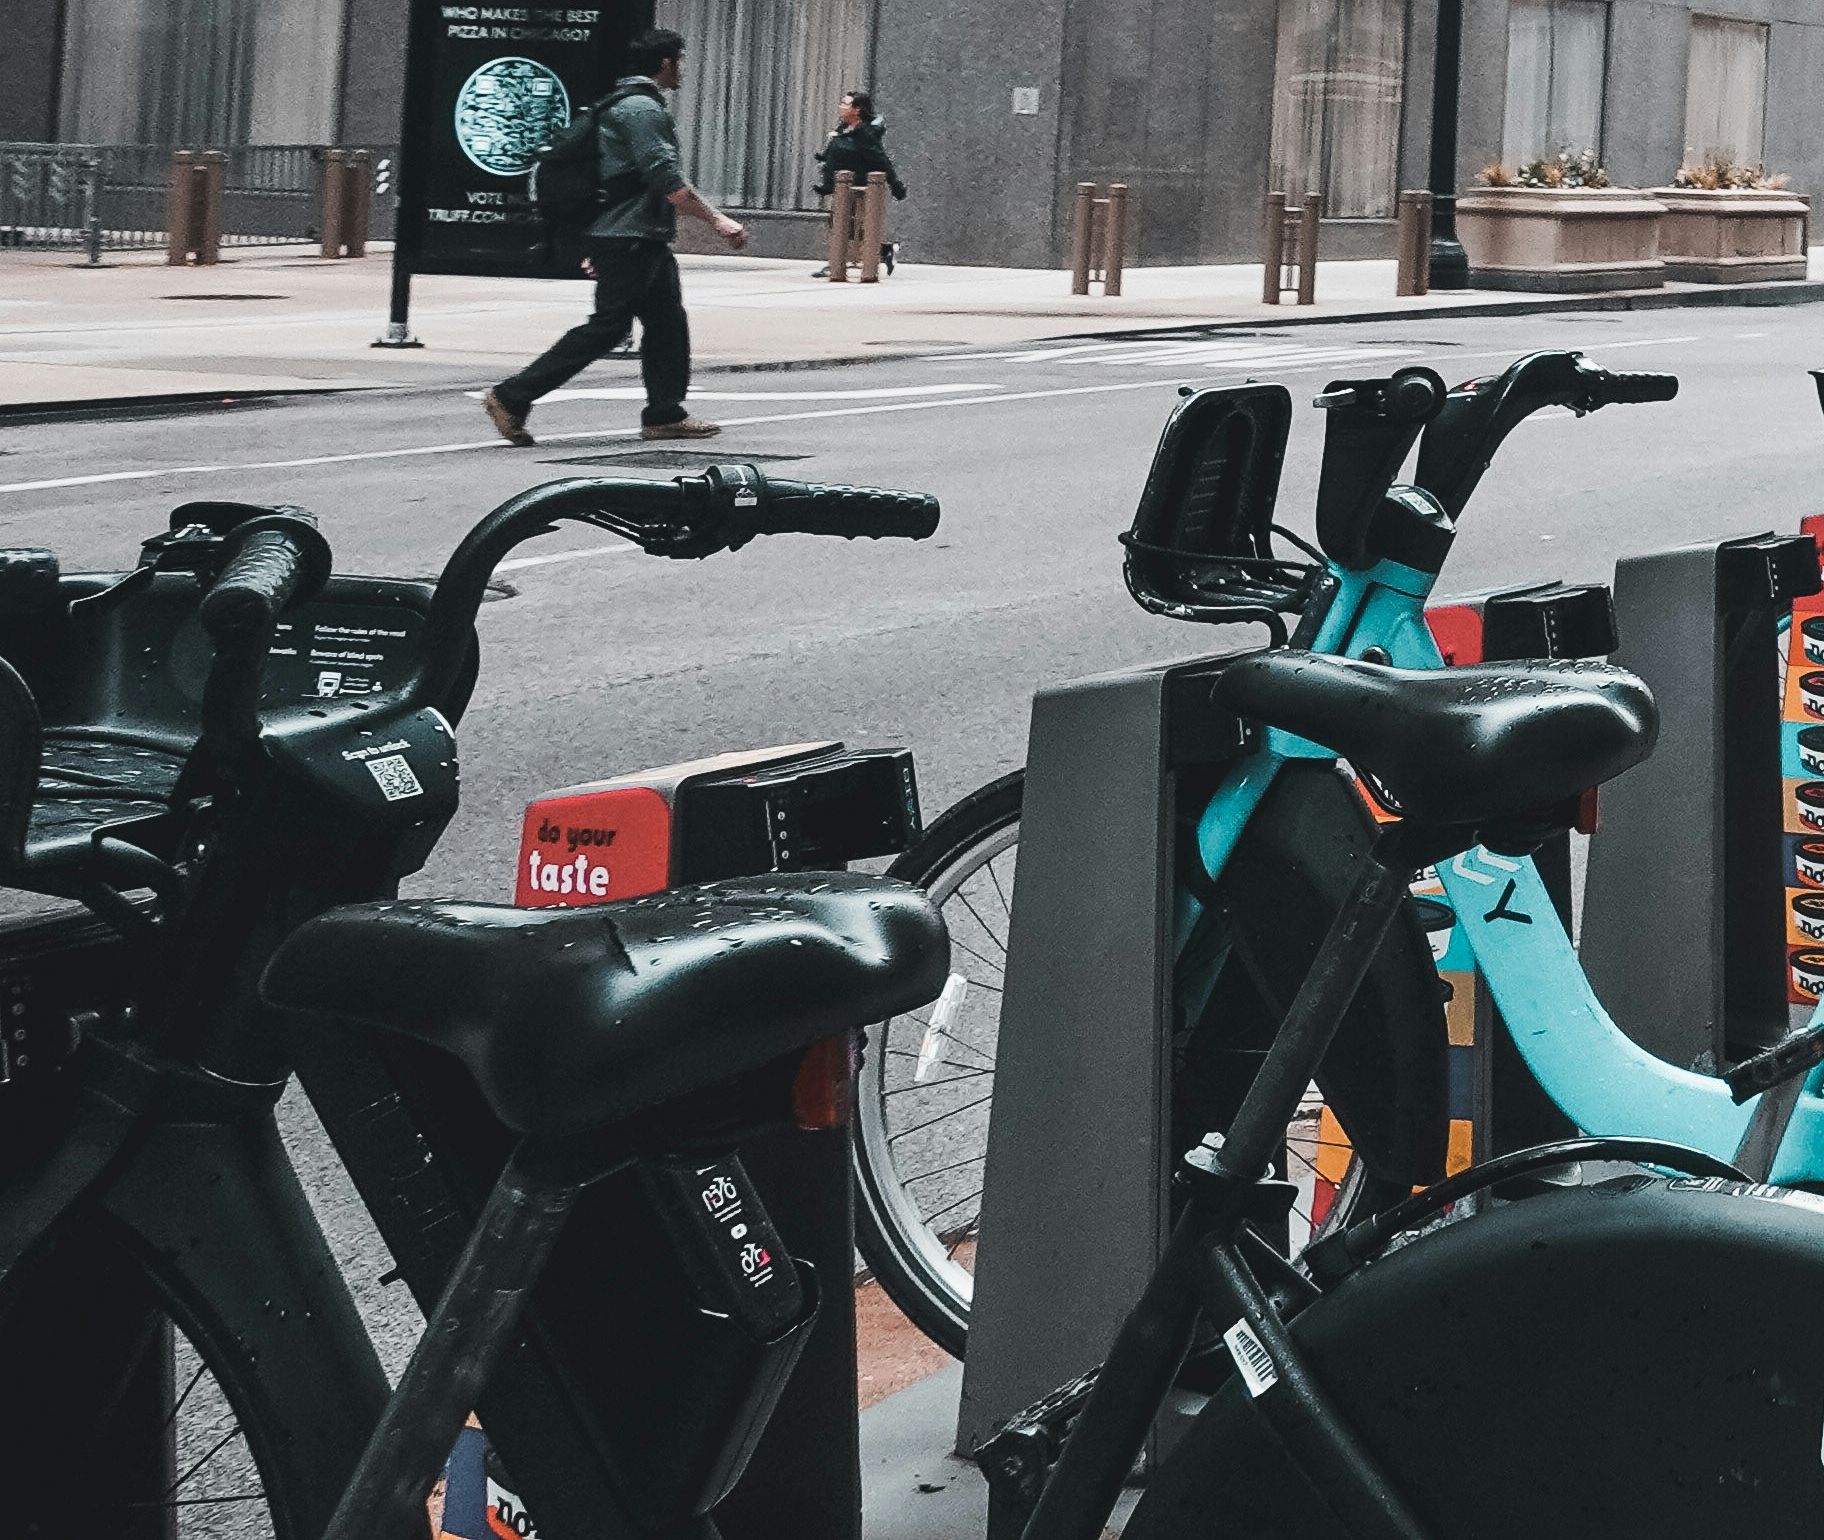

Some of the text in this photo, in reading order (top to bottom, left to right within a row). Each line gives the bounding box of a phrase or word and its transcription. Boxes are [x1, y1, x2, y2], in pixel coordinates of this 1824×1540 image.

[440, 6, 479, 20] WHO
[466, 191, 504, 205] VOTE
[537, 817, 617, 853] do your
[529, 849, 610, 897] taste
